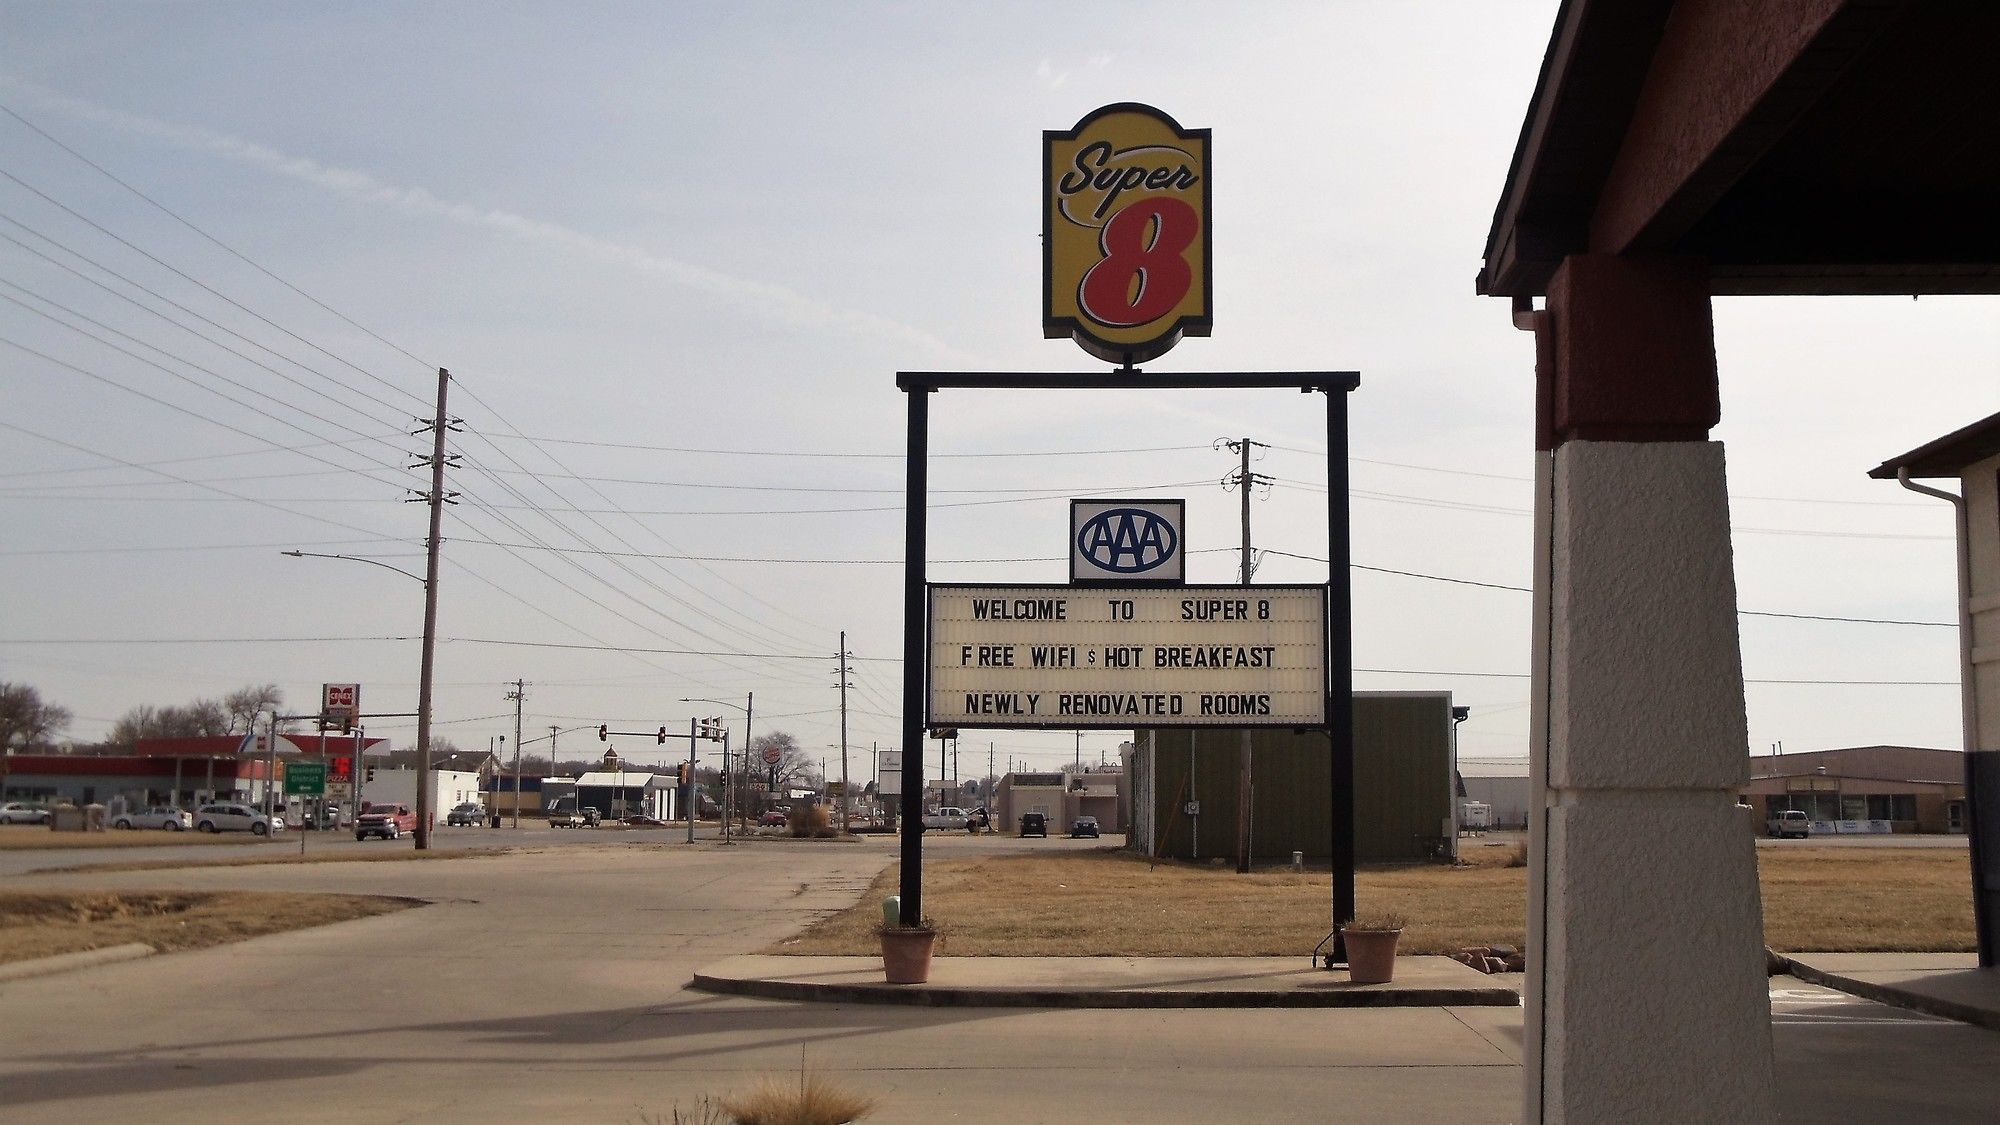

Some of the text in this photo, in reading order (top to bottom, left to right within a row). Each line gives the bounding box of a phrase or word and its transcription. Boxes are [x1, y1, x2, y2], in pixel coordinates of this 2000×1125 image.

[1058, 141, 1200, 219] Super
[1076, 196, 1199, 329] 8
[1085, 508, 1170, 574] AAA
[972, 600, 1271, 621] WELCOME TO SUPER 8
[961, 646, 1014, 667] FREE
[1031, 646, 1077, 667] WIFI
[1104, 646, 1142, 667] HOT
[1154, 646, 1275, 668] BREAKFAST
[965, 693, 1271, 716] NEWLY RENOVATED ROOMS
[291, 775, 319, 783] District
